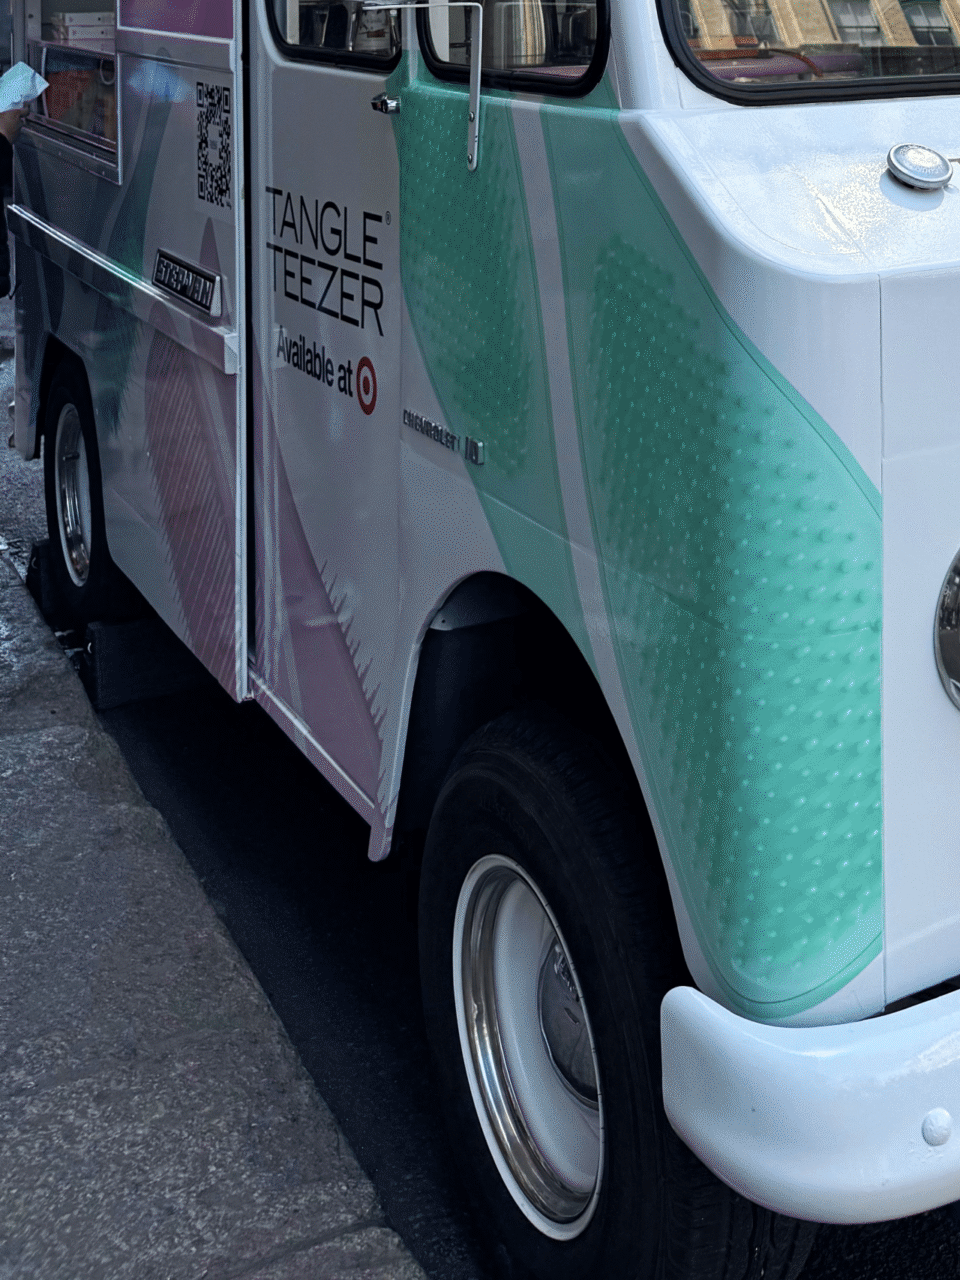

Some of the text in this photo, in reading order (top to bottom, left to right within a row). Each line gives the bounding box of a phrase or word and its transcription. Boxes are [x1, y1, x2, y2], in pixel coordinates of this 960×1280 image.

[266, 241, 385, 338] TEEZER
[277, 324, 354, 398] Available at
[403, 409, 457, 452] CHEVROLET
